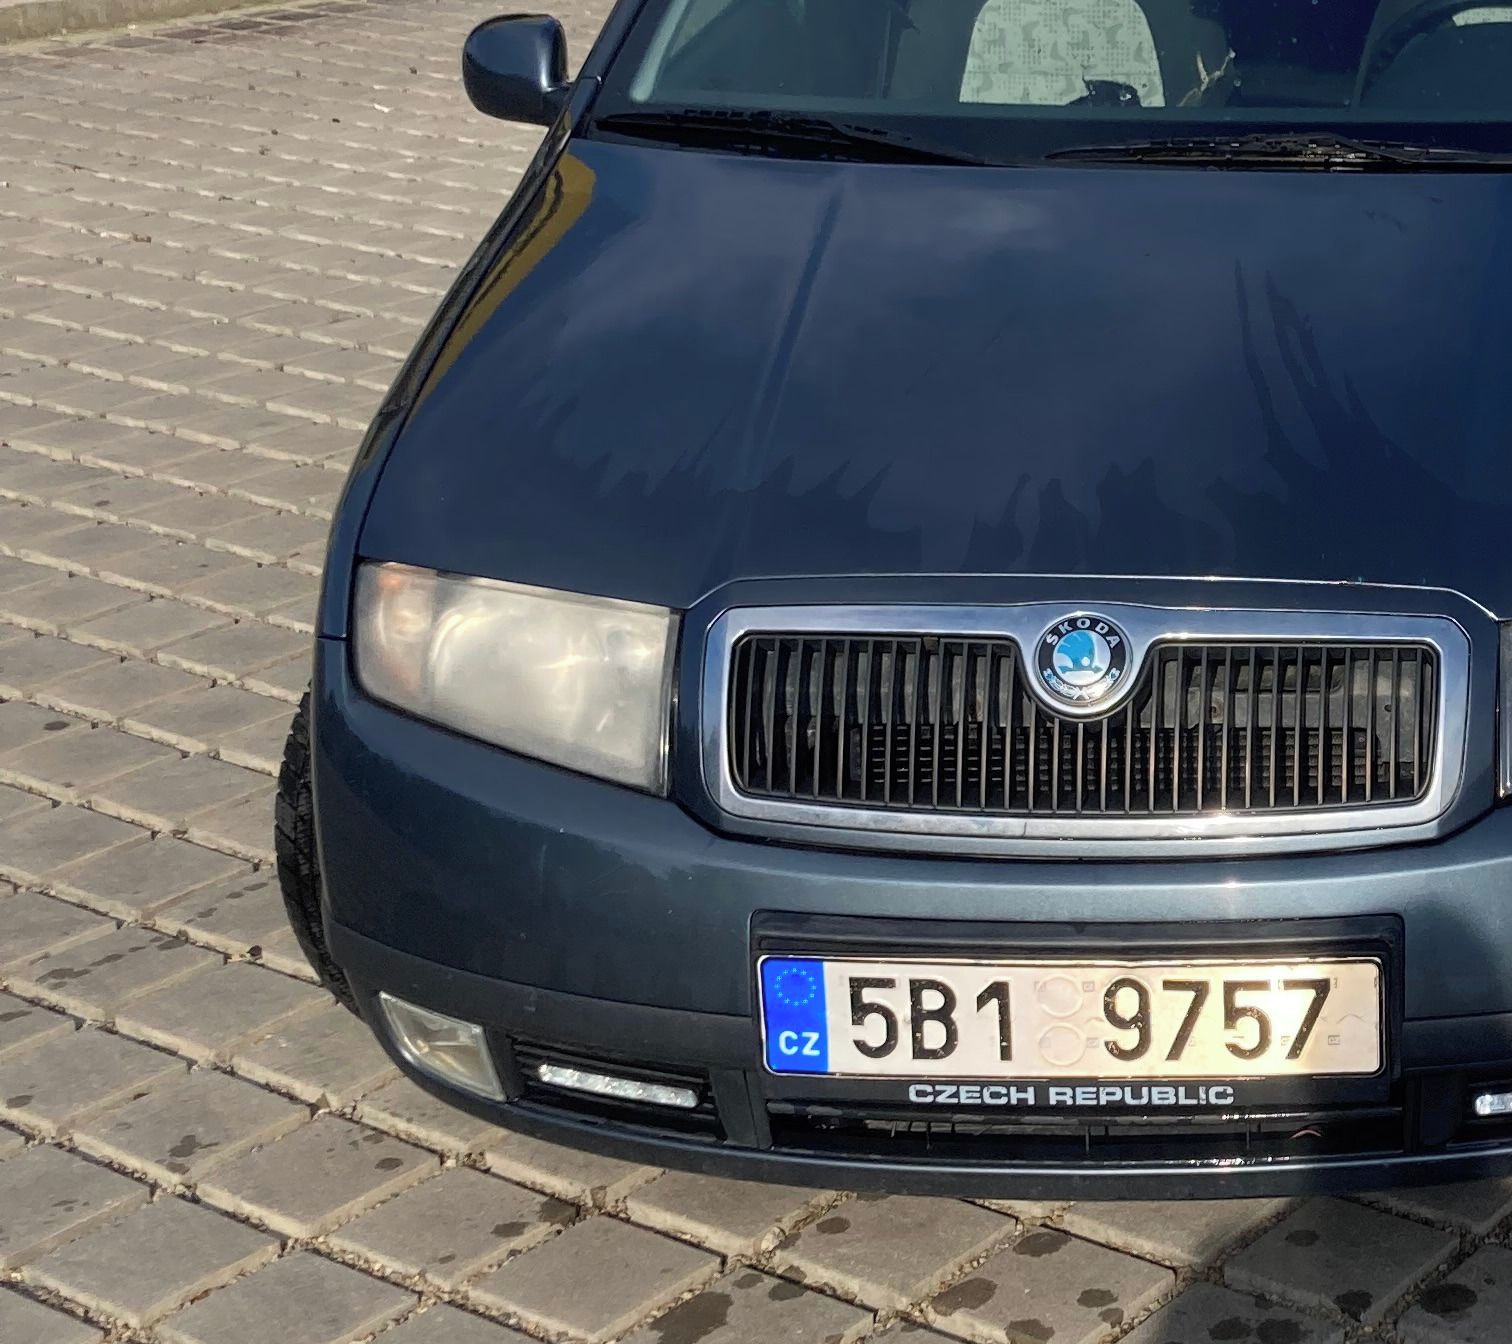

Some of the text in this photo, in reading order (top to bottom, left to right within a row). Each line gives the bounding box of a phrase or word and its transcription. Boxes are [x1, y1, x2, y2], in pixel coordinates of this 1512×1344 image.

[848, 977, 1331, 1061] 5B1 9757
[779, 1030, 820, 1056] CZ
[908, 1084, 1235, 1106] CZECH REPUBLIC
